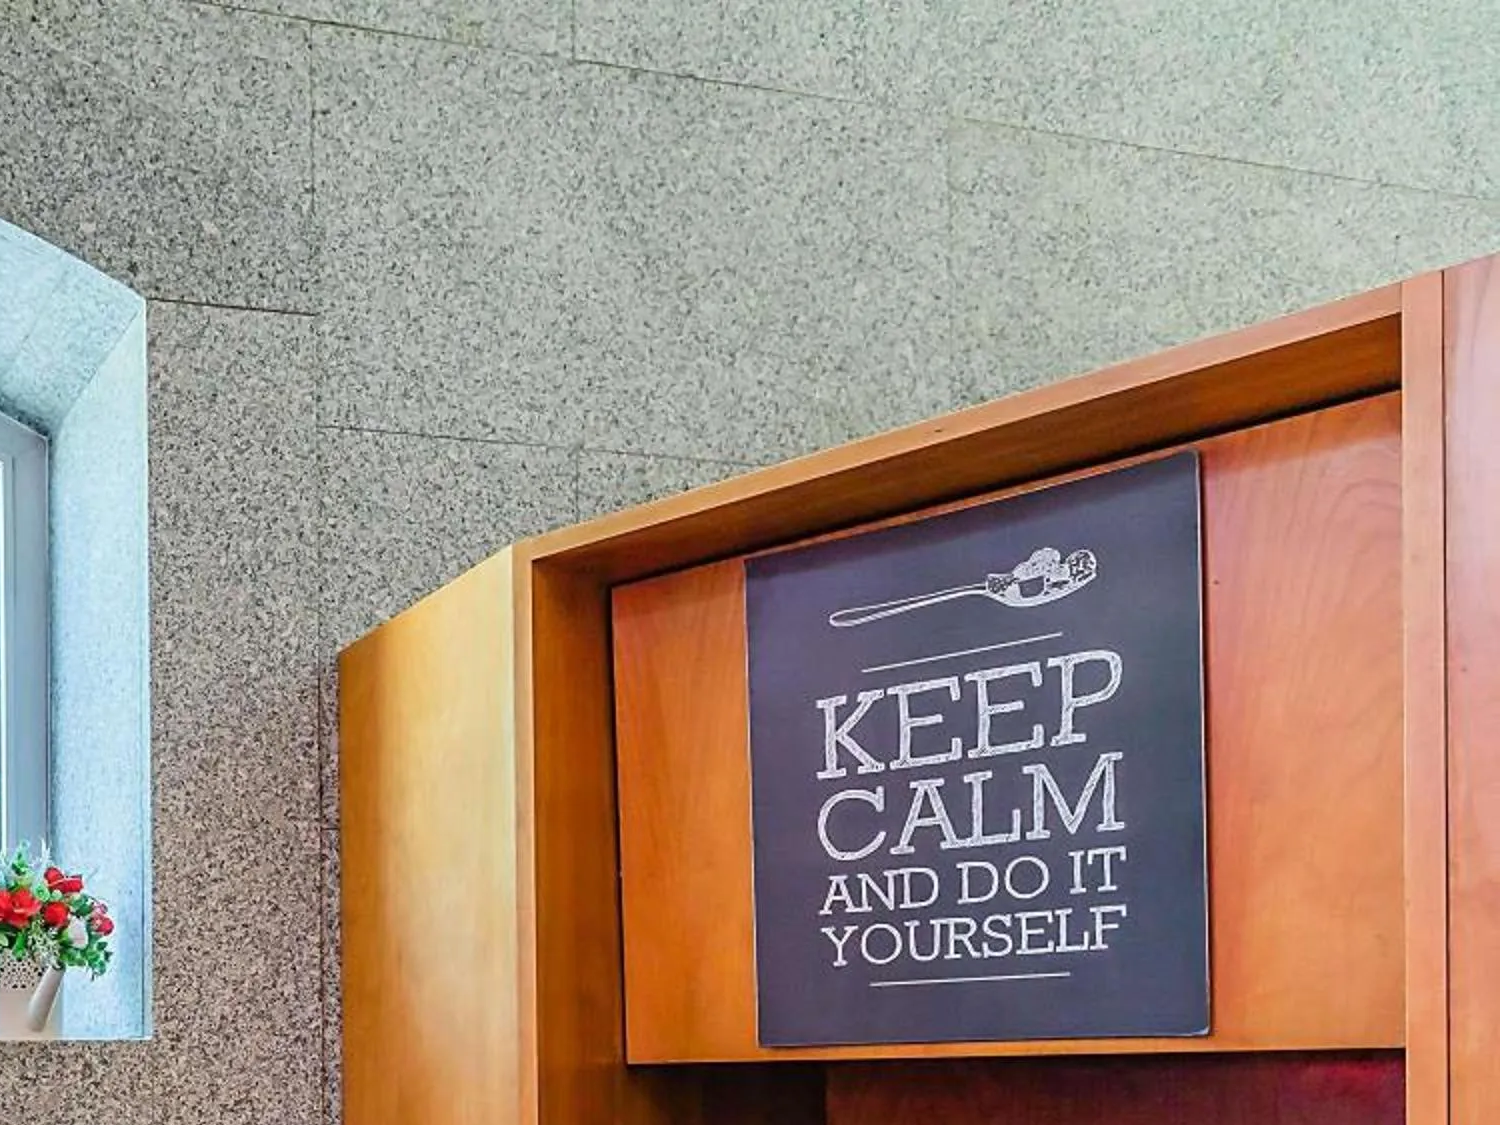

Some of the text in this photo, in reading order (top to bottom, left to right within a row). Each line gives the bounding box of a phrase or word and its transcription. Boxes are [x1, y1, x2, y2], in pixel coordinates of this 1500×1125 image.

[815, 649, 1123, 780] KEEP
[816, 751, 1125, 861] CALM
[819, 845, 1127, 915] AND DO IT
[820, 904, 1127, 967] YOURSELF
